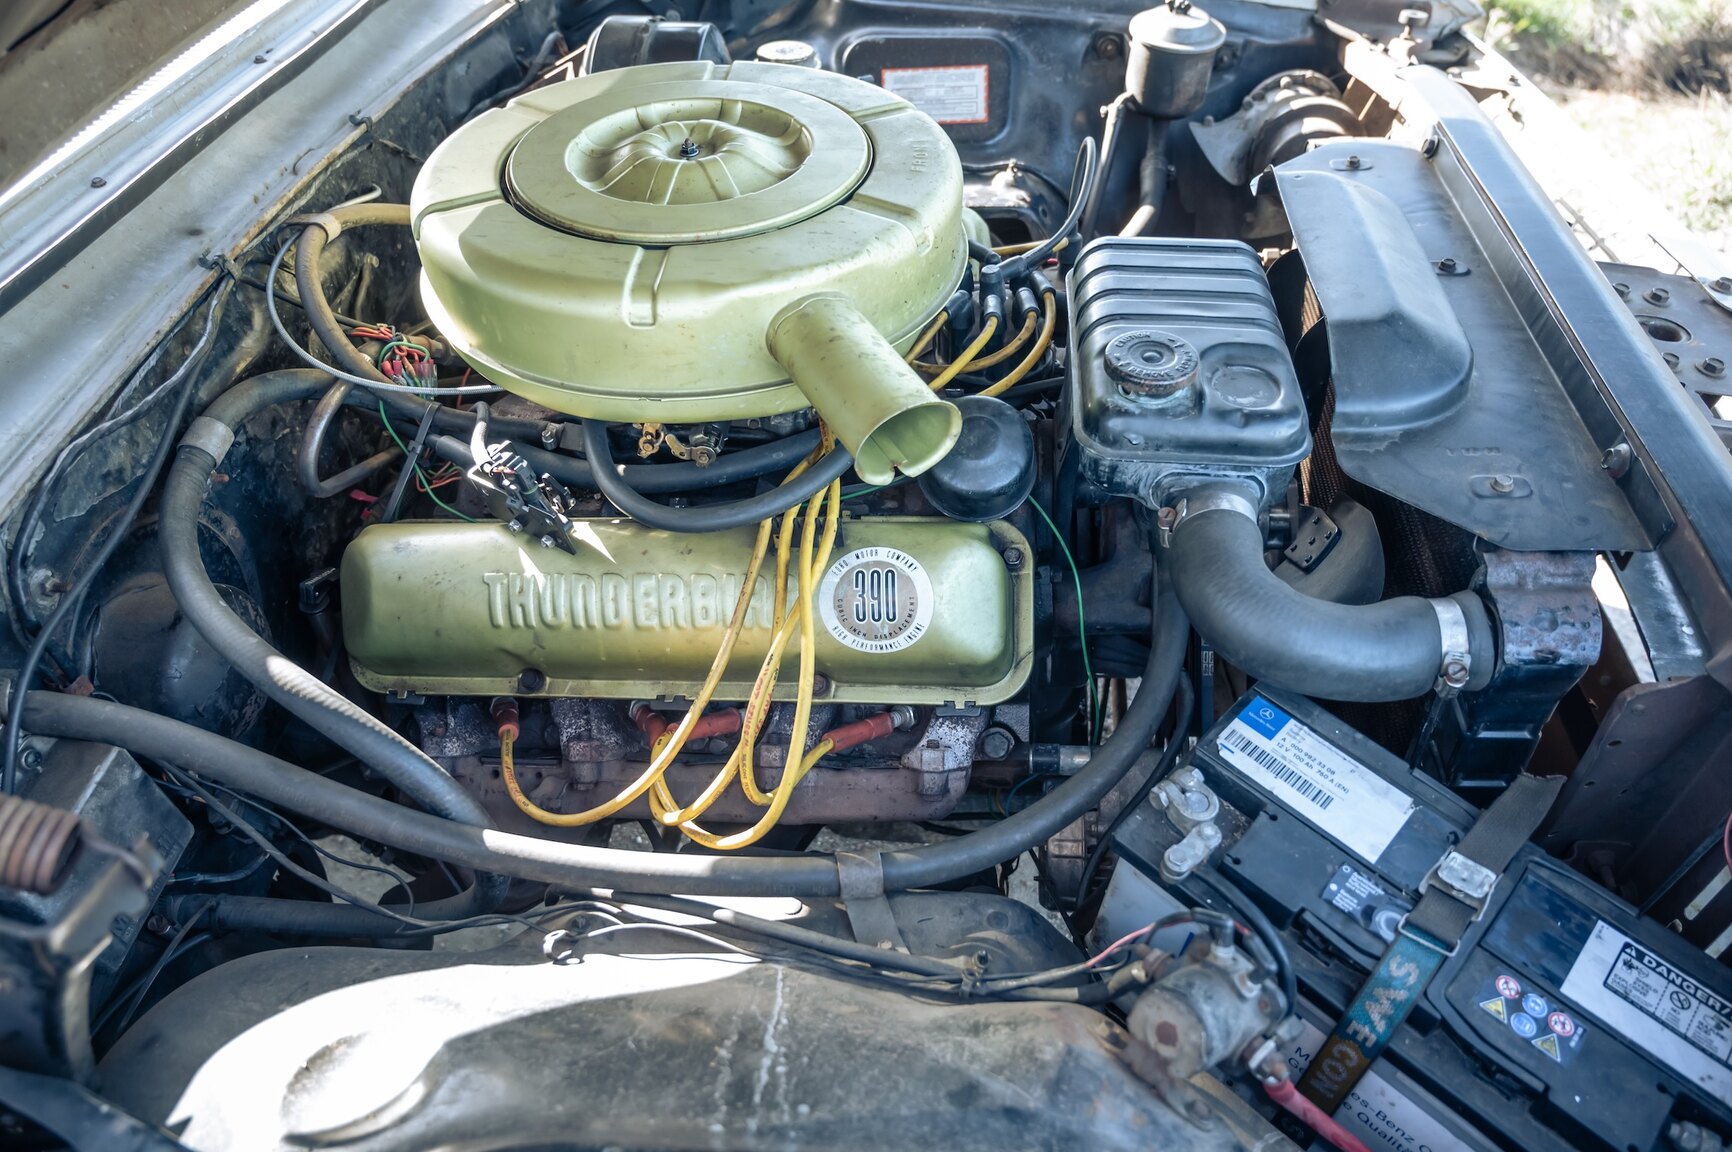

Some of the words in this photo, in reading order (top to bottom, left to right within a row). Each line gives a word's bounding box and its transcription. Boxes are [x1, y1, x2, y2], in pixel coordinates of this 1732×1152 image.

[1128, 365, 1173, 378] REMOVE
[831, 559, 849, 576] FORD
[854, 549, 878, 560] MOTOR
[886, 550, 917, 573] COMPANY
[854, 568, 897, 623] 390
[837, 598, 848, 623] CUBIC
[849, 625, 867, 638] INCH
[874, 596, 915, 640] DISPLACEMENT
[832, 625, 848, 641] HIGH
[851, 639, 901, 651] PERFORMANCE
[903, 623, 925, 644] ENGINE
[1293, 753, 1304, 763] 100
